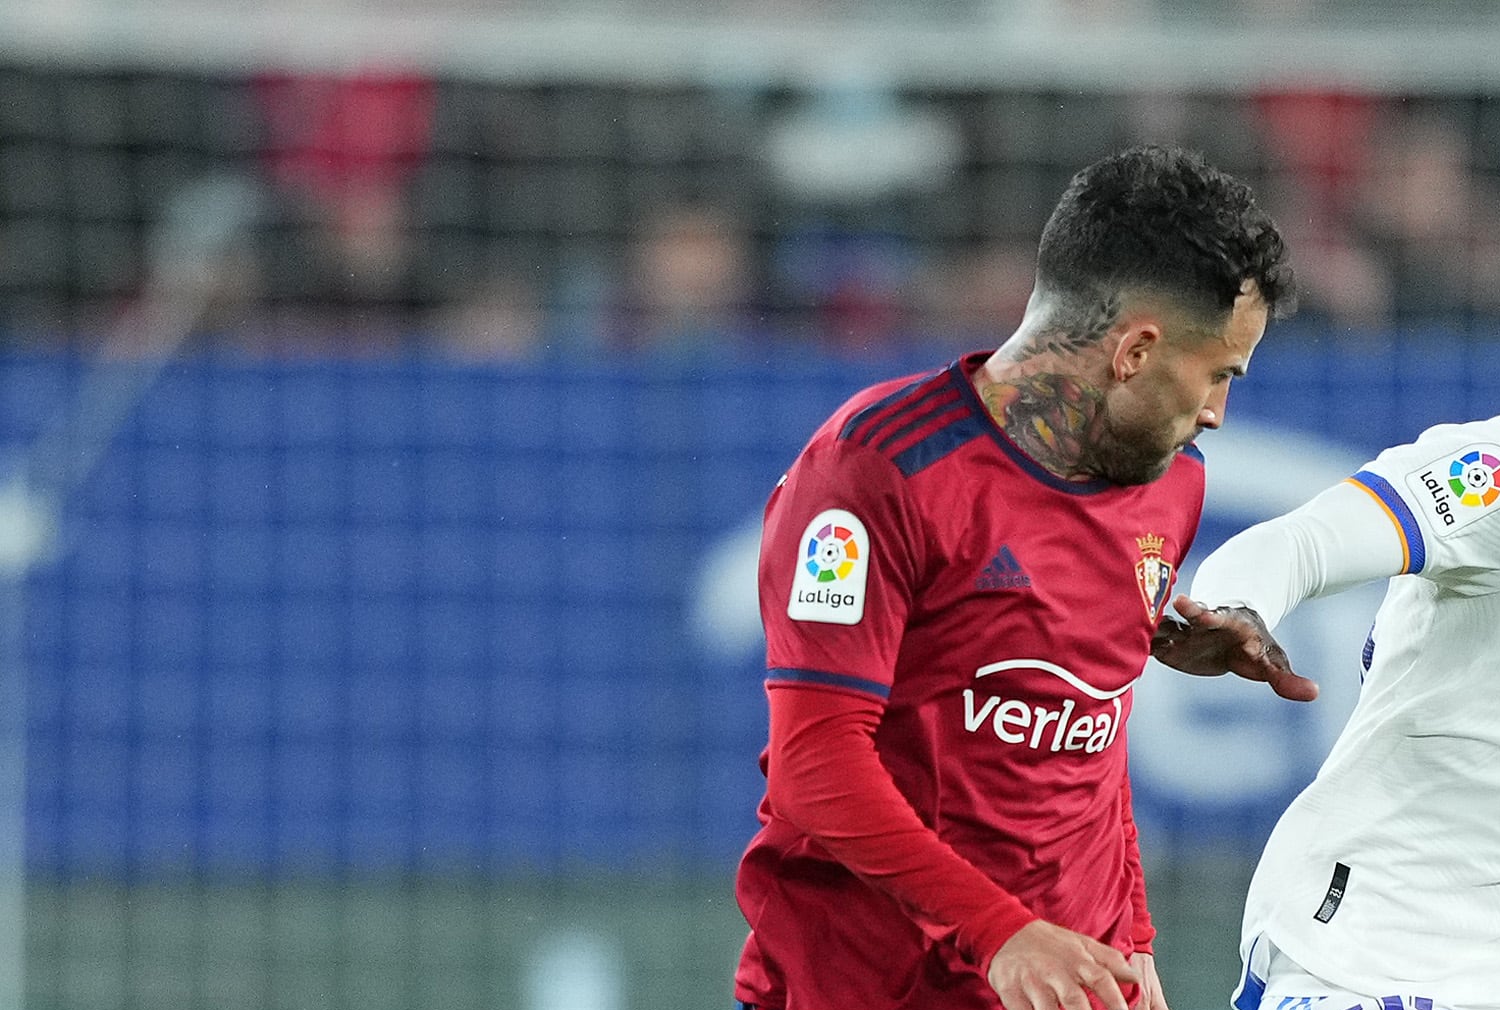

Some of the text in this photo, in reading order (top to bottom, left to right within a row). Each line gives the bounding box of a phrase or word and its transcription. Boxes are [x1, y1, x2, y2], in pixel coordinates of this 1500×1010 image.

[1420, 471, 1455, 526] LaLiga
[798, 589, 855, 608] LaLiga
[963, 689, 1122, 753] verleal
